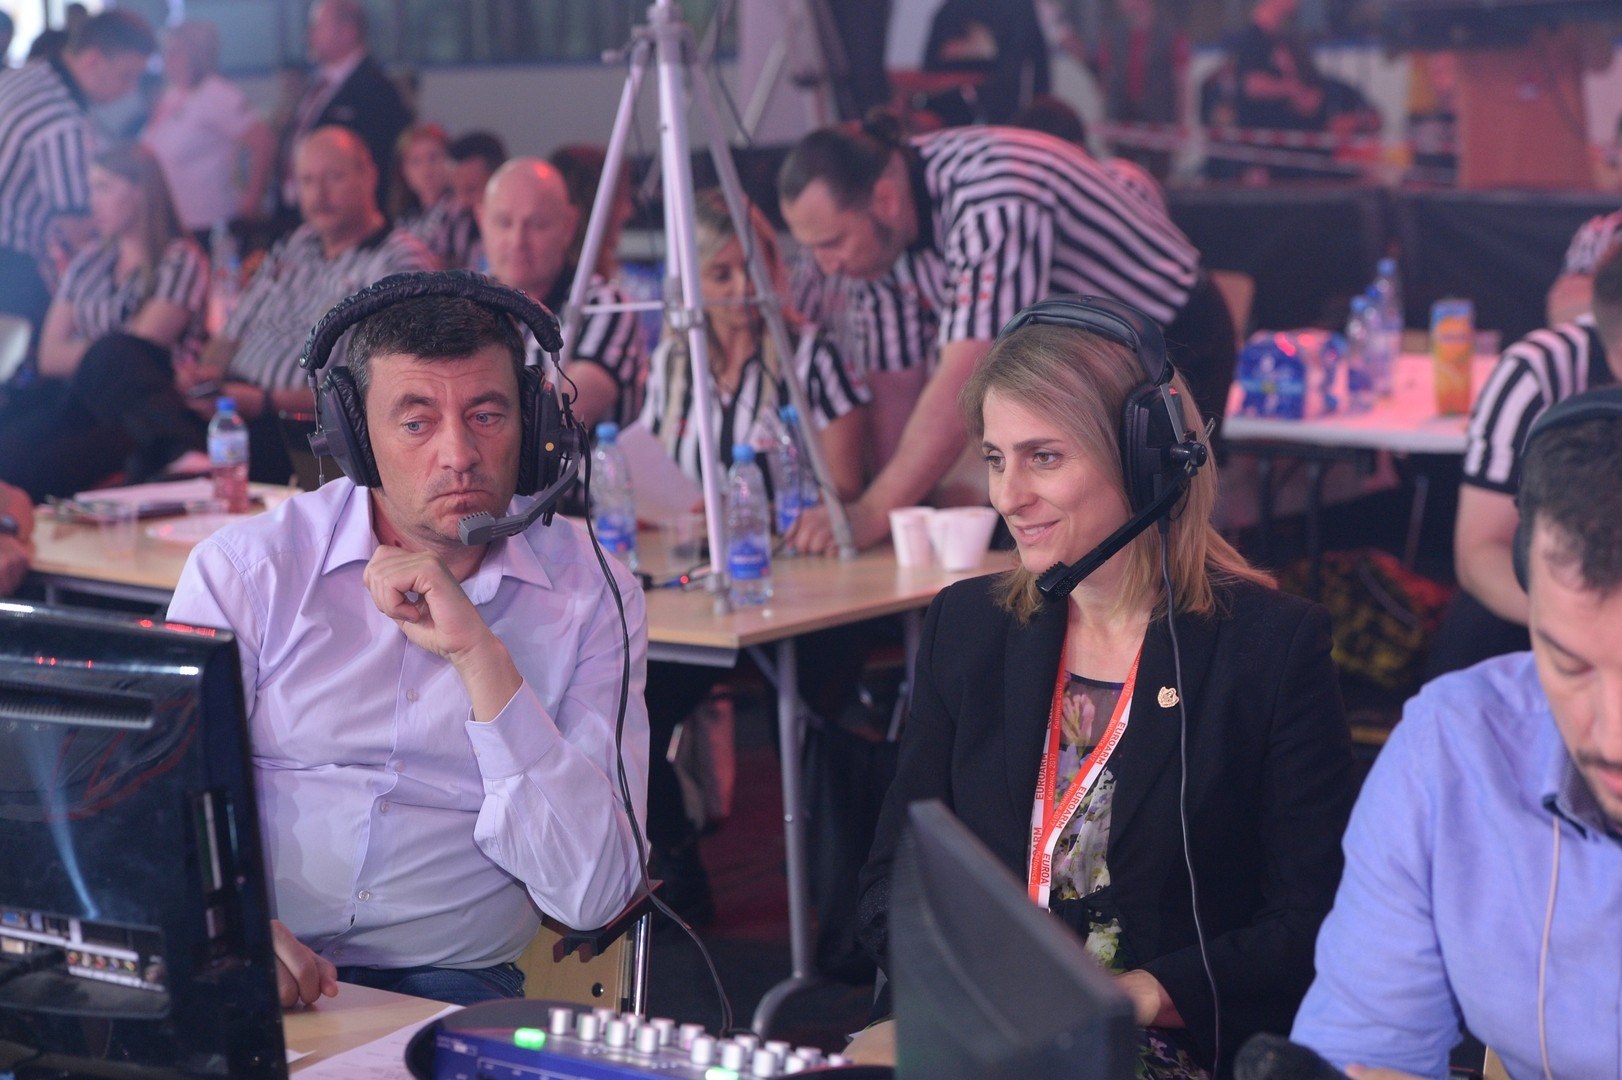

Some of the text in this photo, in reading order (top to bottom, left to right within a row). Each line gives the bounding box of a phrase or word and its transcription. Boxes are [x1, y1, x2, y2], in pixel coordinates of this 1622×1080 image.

[1053, 700, 1062, 730] Katowice
[1096, 721, 1126, 765] EUROARM
[1047, 771, 1056, 801] Katowice
[1058, 783, 1078, 811] Katowice
[1055, 786, 1087, 829] EUROARM
[1031, 850, 1042, 880] Katowice
[1041, 853, 1051, 884] EUROA
